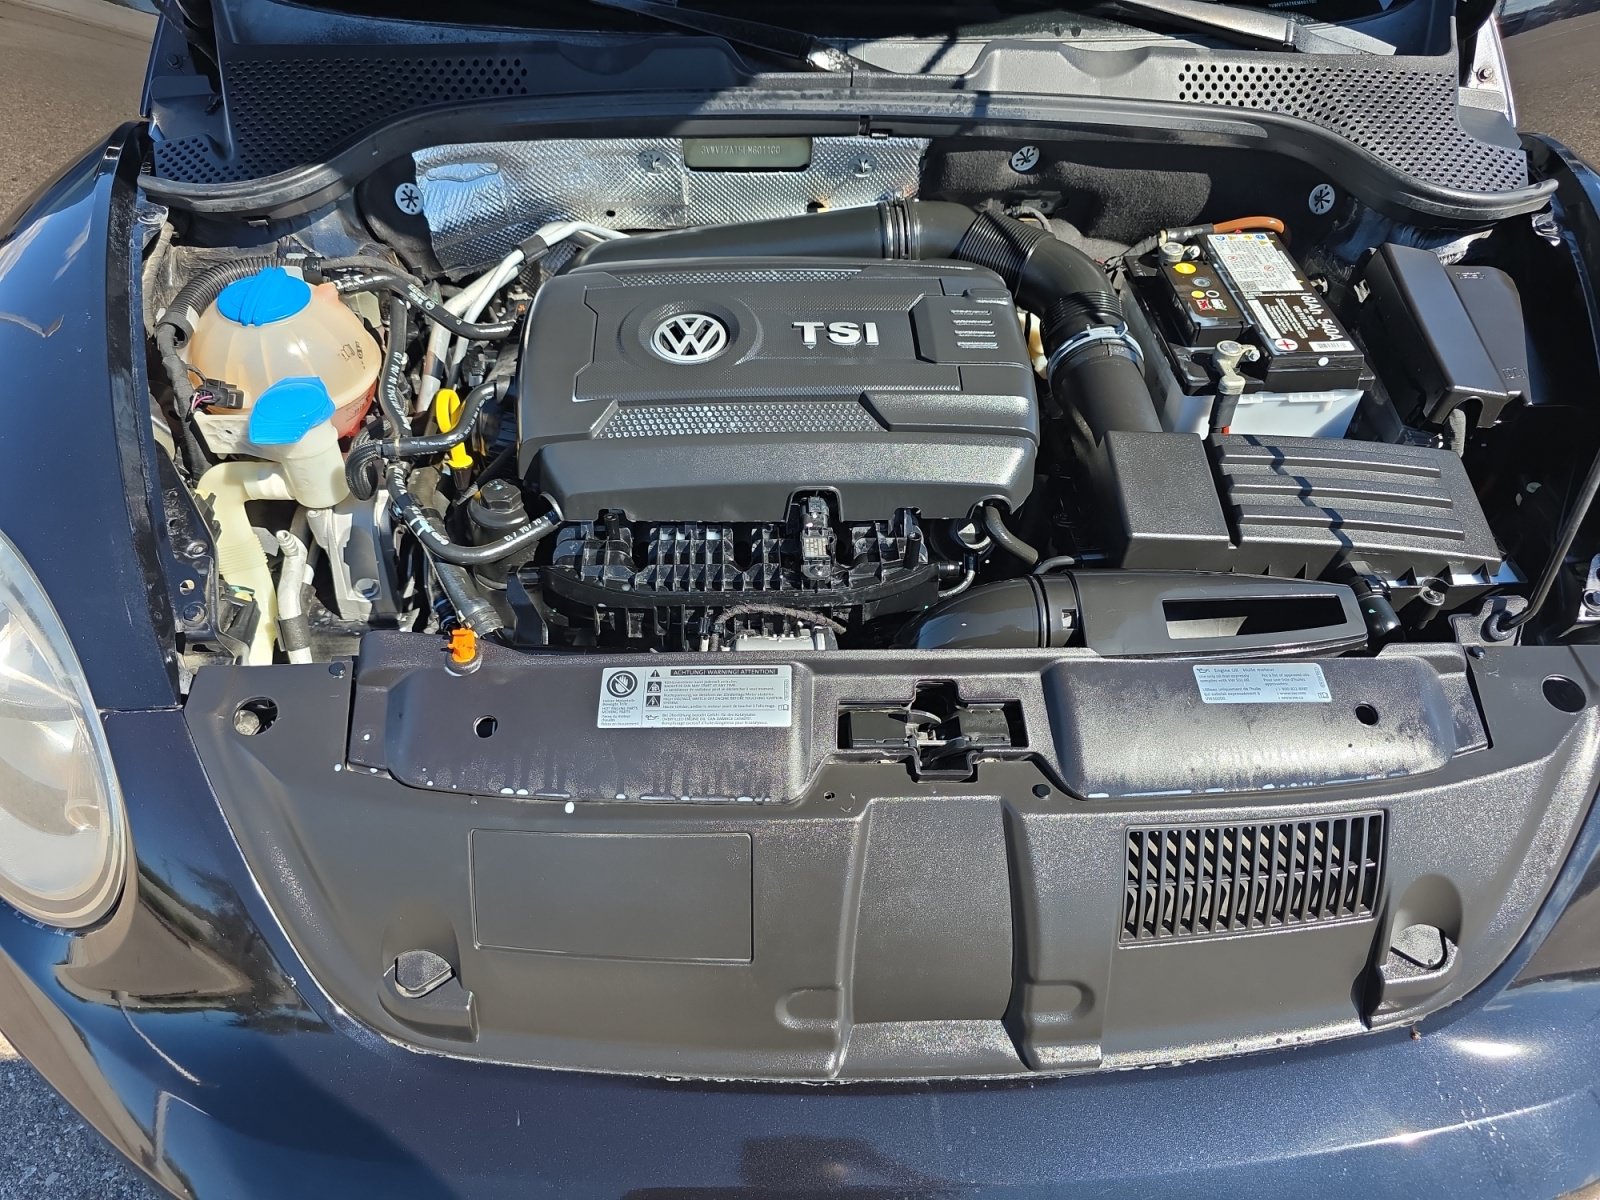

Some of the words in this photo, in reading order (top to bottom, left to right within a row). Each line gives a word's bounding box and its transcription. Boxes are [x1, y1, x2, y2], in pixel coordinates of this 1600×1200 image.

[652, 312, 728, 364] VW
[792, 320, 880, 348] TSI
[1301, 296, 1324, 315] 61Ah
[1317, 319, 1344, 341] 540A
